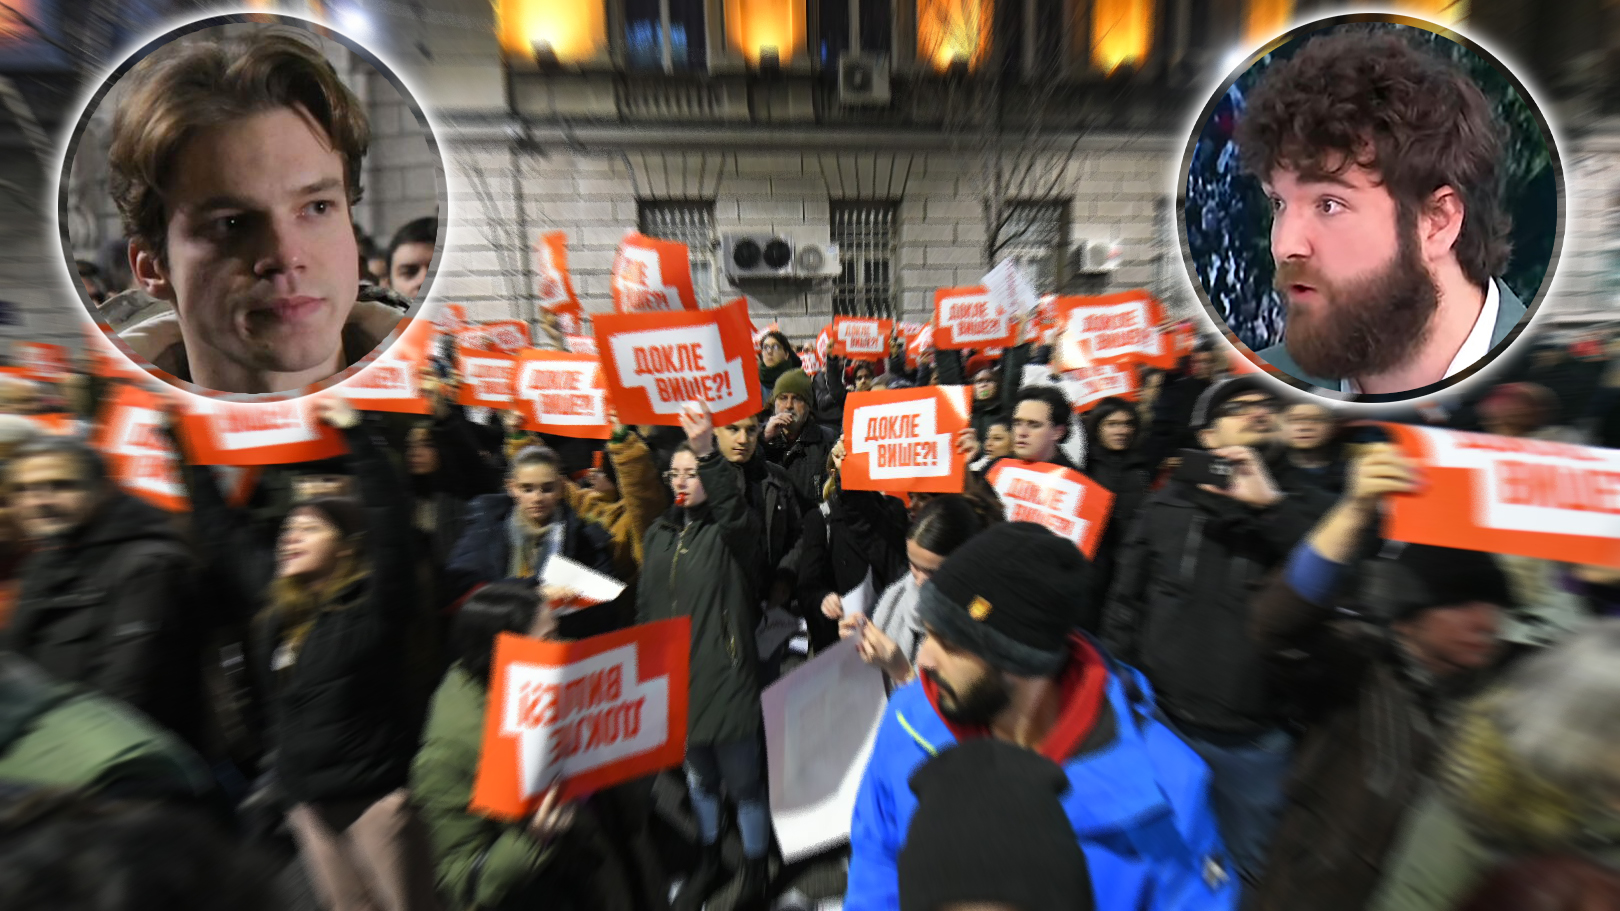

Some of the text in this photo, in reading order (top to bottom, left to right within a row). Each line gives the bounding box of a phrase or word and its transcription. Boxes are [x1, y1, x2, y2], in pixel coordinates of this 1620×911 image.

[632, 342, 706, 376] ДОКЛЕ
[653, 370, 733, 402] ВИШЕ?!
[864, 413, 921, 442] ДОКЛЕ
[877, 441, 938, 467] ВИШЕ?!
